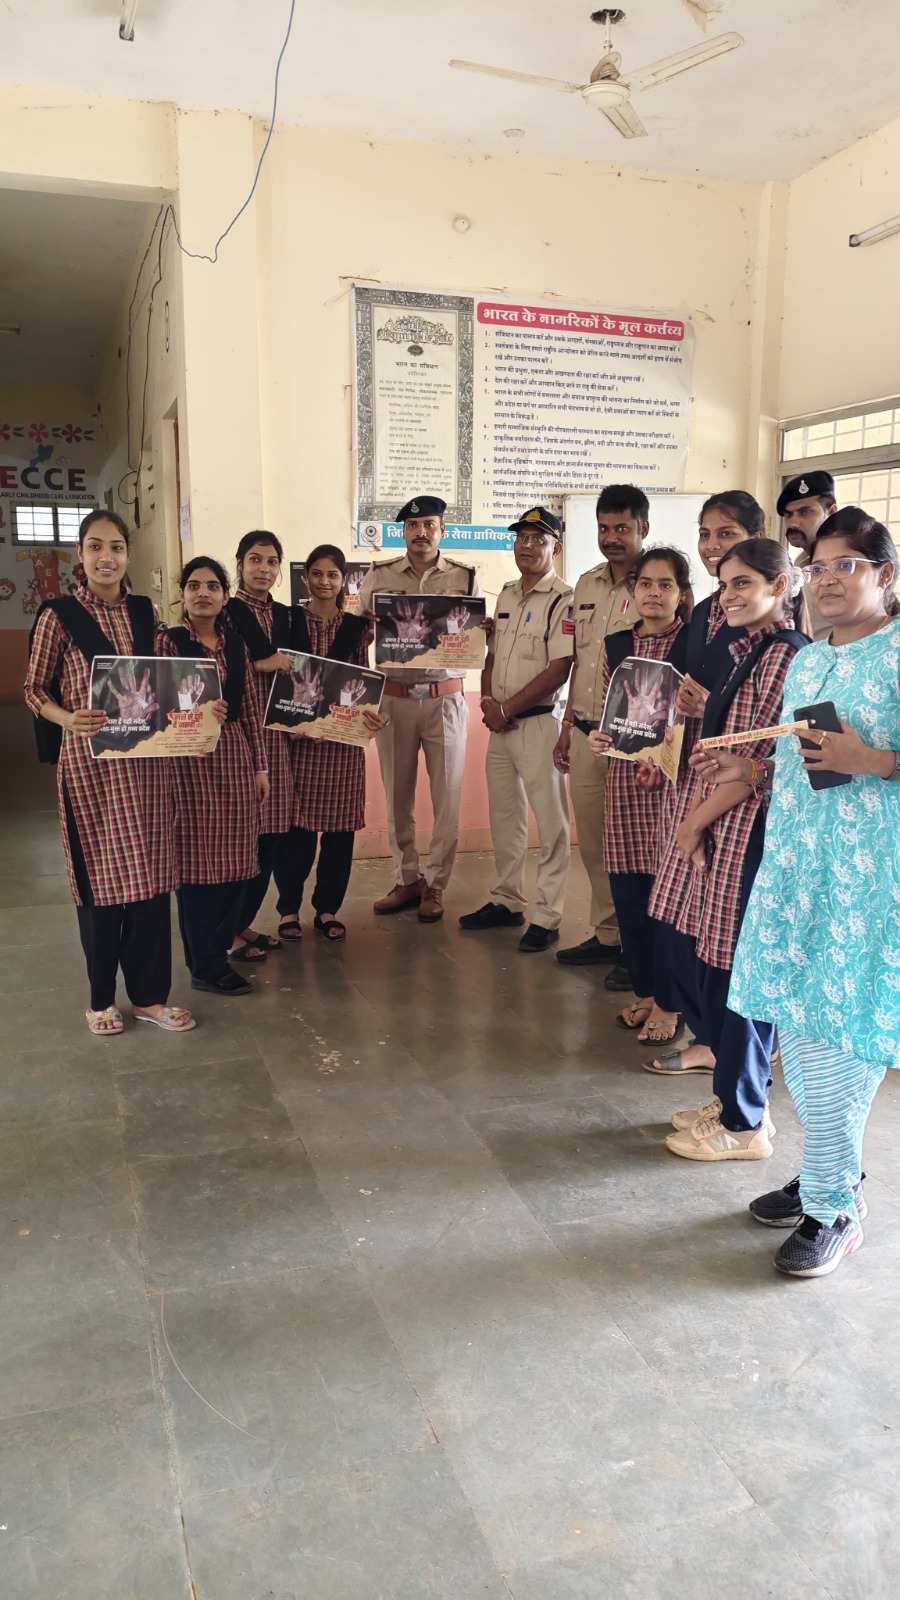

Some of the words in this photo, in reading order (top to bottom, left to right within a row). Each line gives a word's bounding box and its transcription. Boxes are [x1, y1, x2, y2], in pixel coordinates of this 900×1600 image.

[484, 308, 519, 321] भारत
[522, 308, 536, 323] के
[539, 313, 599, 329] नागरिकों
[602, 316, 616, 330] के
[619, 321, 641, 335] मूल
[0, 466, 86, 491] ECCE
[451, 528, 472, 540] सेवा
[35, 559, 44, 568] A
[46, 568, 52, 576] E
